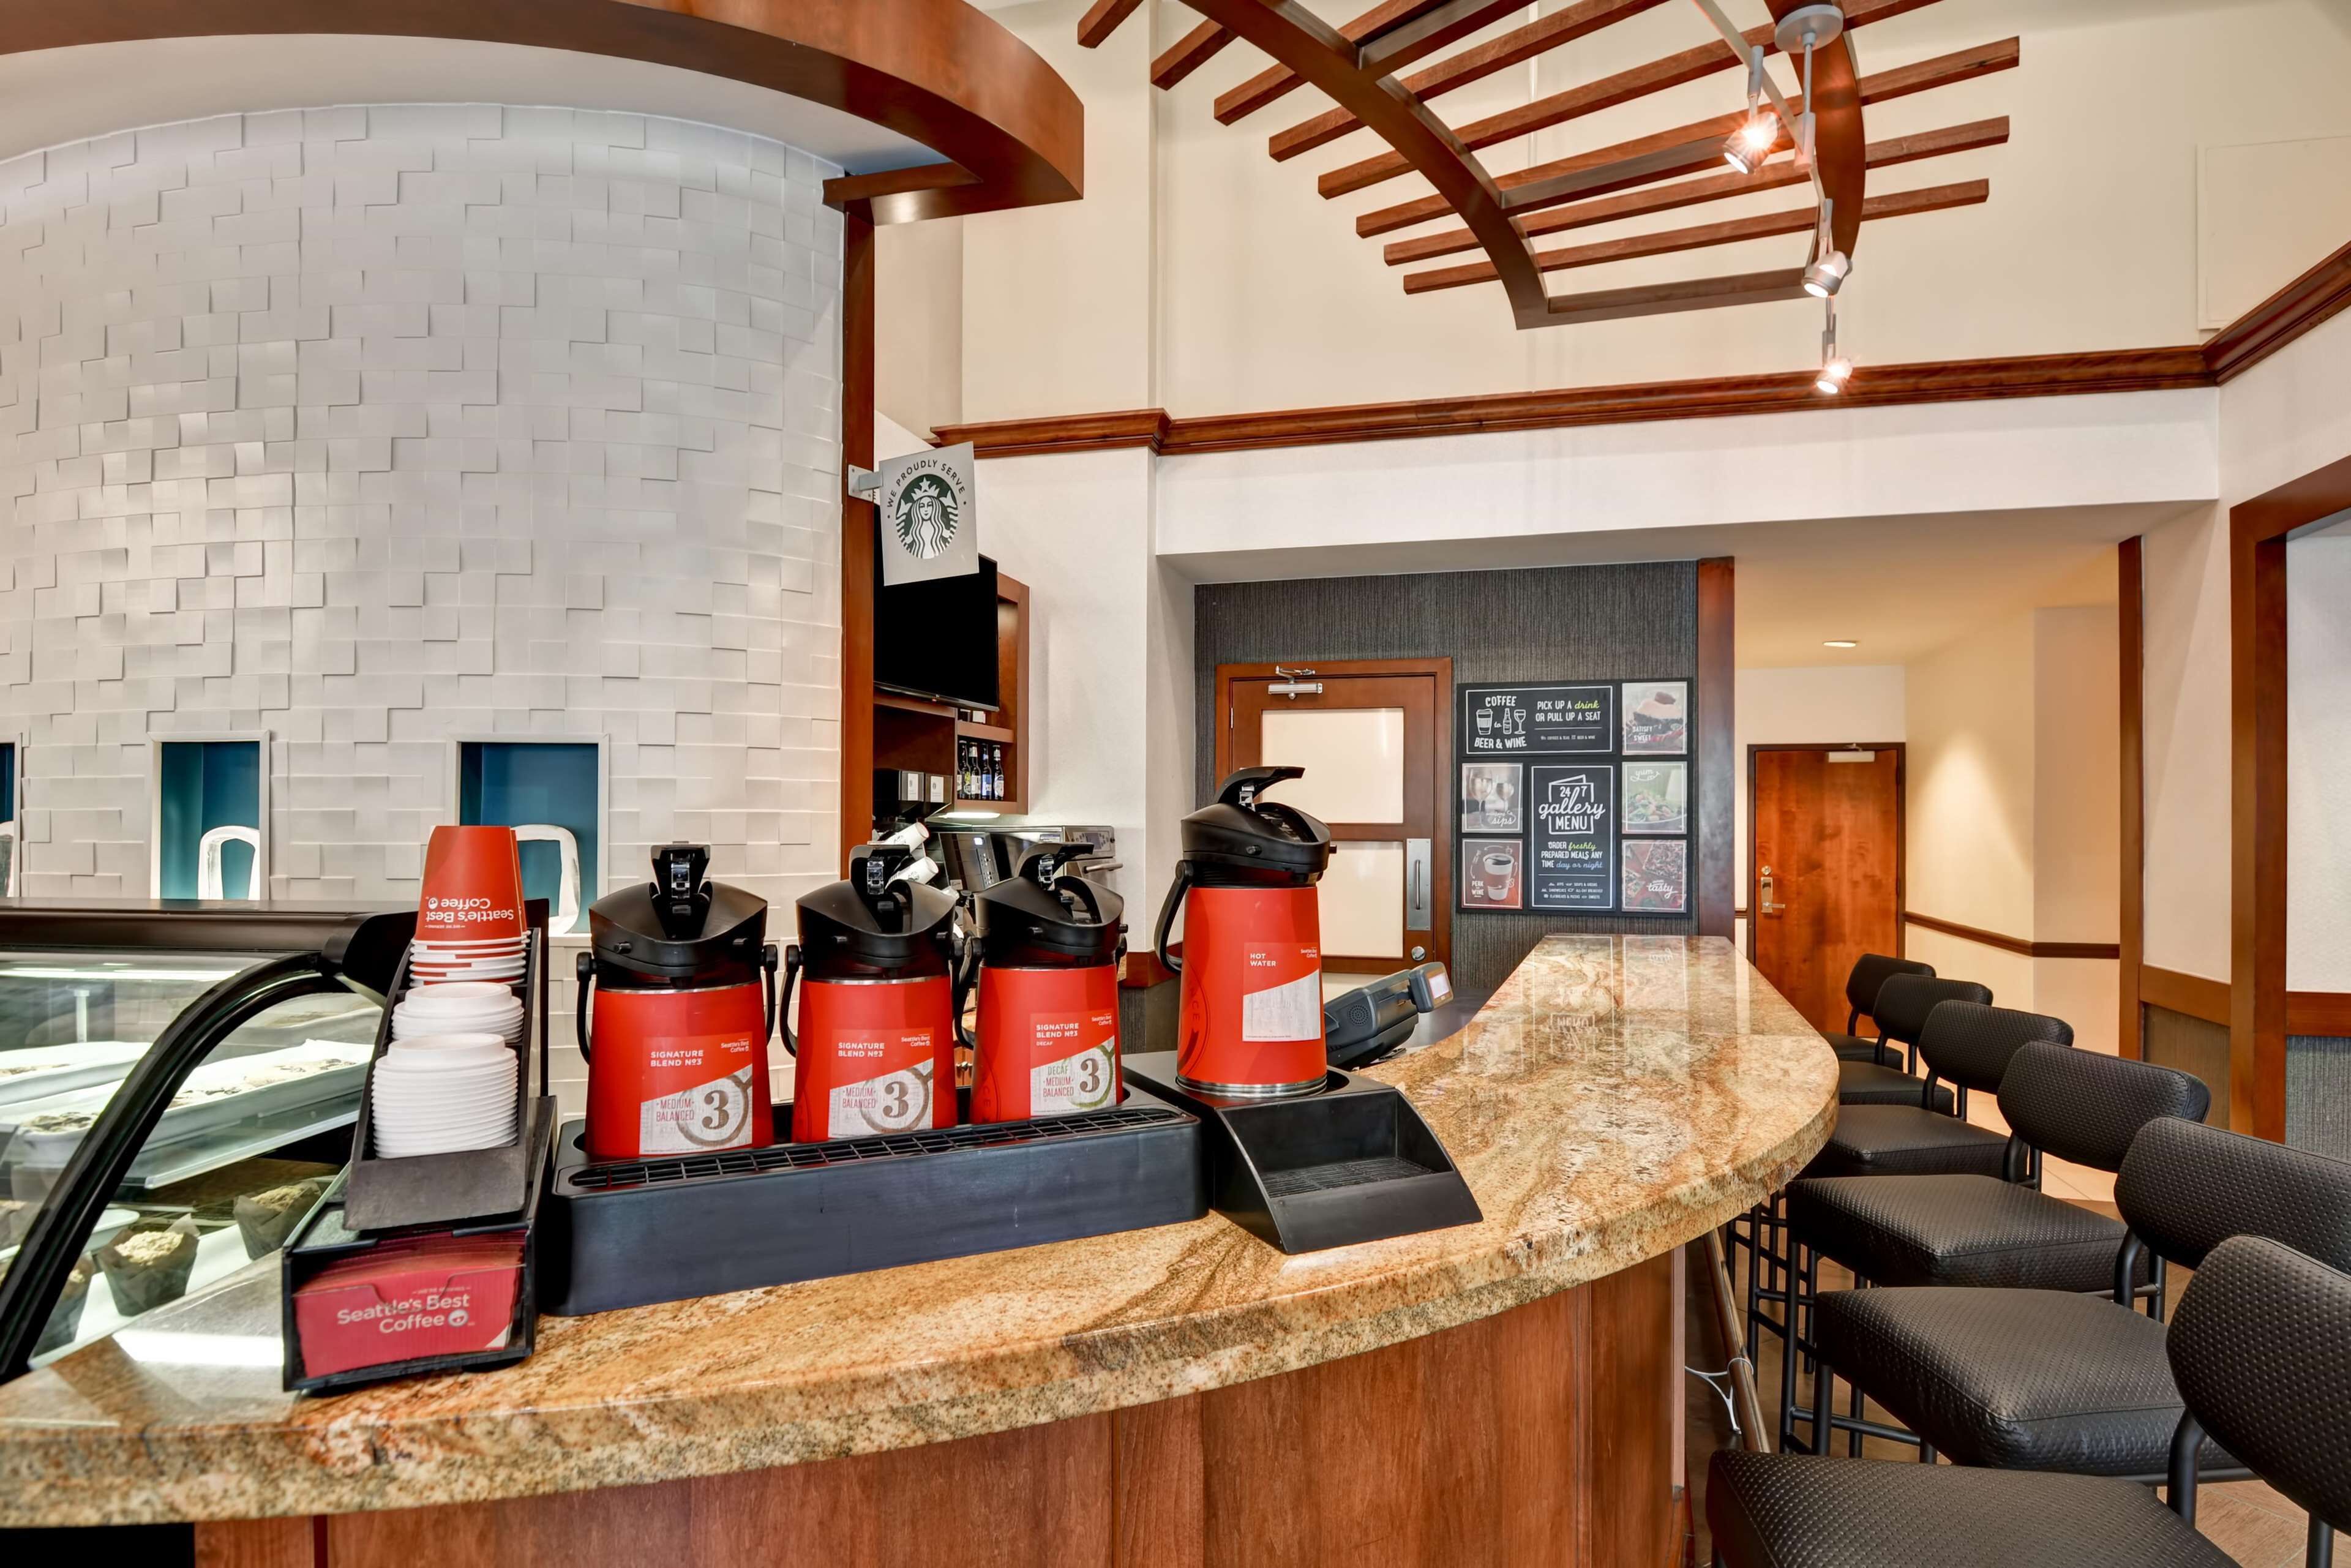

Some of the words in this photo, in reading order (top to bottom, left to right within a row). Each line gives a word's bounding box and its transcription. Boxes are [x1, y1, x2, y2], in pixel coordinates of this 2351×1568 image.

[887, 490, 897, 508] WE
[896, 460, 938, 486] PROUDLY
[941, 463, 965, 493] SERVE
[1485, 696, 1517, 707] COFFEE
[1537, 700, 1553, 710] PICK
[1555, 700, 1565, 710] UP
[1567, 701, 1572, 710] A
[1574, 700, 1600, 710] drink
[1535, 713, 1545, 722] OR
[1547, 712, 1563, 721] PULL
[1565, 712, 1575, 721] UP
[1578, 712, 1583, 721] A
[1585, 711, 1601, 721] SEAT
[1474, 738, 1494, 749] BEER
[1496, 740, 1502, 749] &
[1505, 737, 1527, 748] WINE
[1538, 786, 1606, 819] gallery
[1556, 816, 1588, 830] MENU
[1569, 842, 1597, 851] freshly
[1570, 851, 1589, 860] MEALS
[1556, 861, 1571, 870] day
[1583, 861, 1603, 870] night
[1646, 883, 1678, 899] tasty
[440, 898, 490, 910] Coffee
[426, 911, 454, 923] Best
[458, 909, 514, 923] Seattle's
[650, 1049, 704, 1059] SIGNATURE
[1048, 1066, 1068, 1075] DECAF
[1079, 1058, 1100, 1093] 3
[1043, 1087, 1074, 1097] BALANCED
[842, 1098, 876, 1108] BALANCED
[882, 1081, 909, 1118] 3
[656, 1110, 695, 1122] BALANCED
[702, 1090, 730, 1130] 3
[337, 1298, 422, 1325] Seattle's
[426, 1294, 470, 1310] Best
[379, 1314, 445, 1334] Coffee
